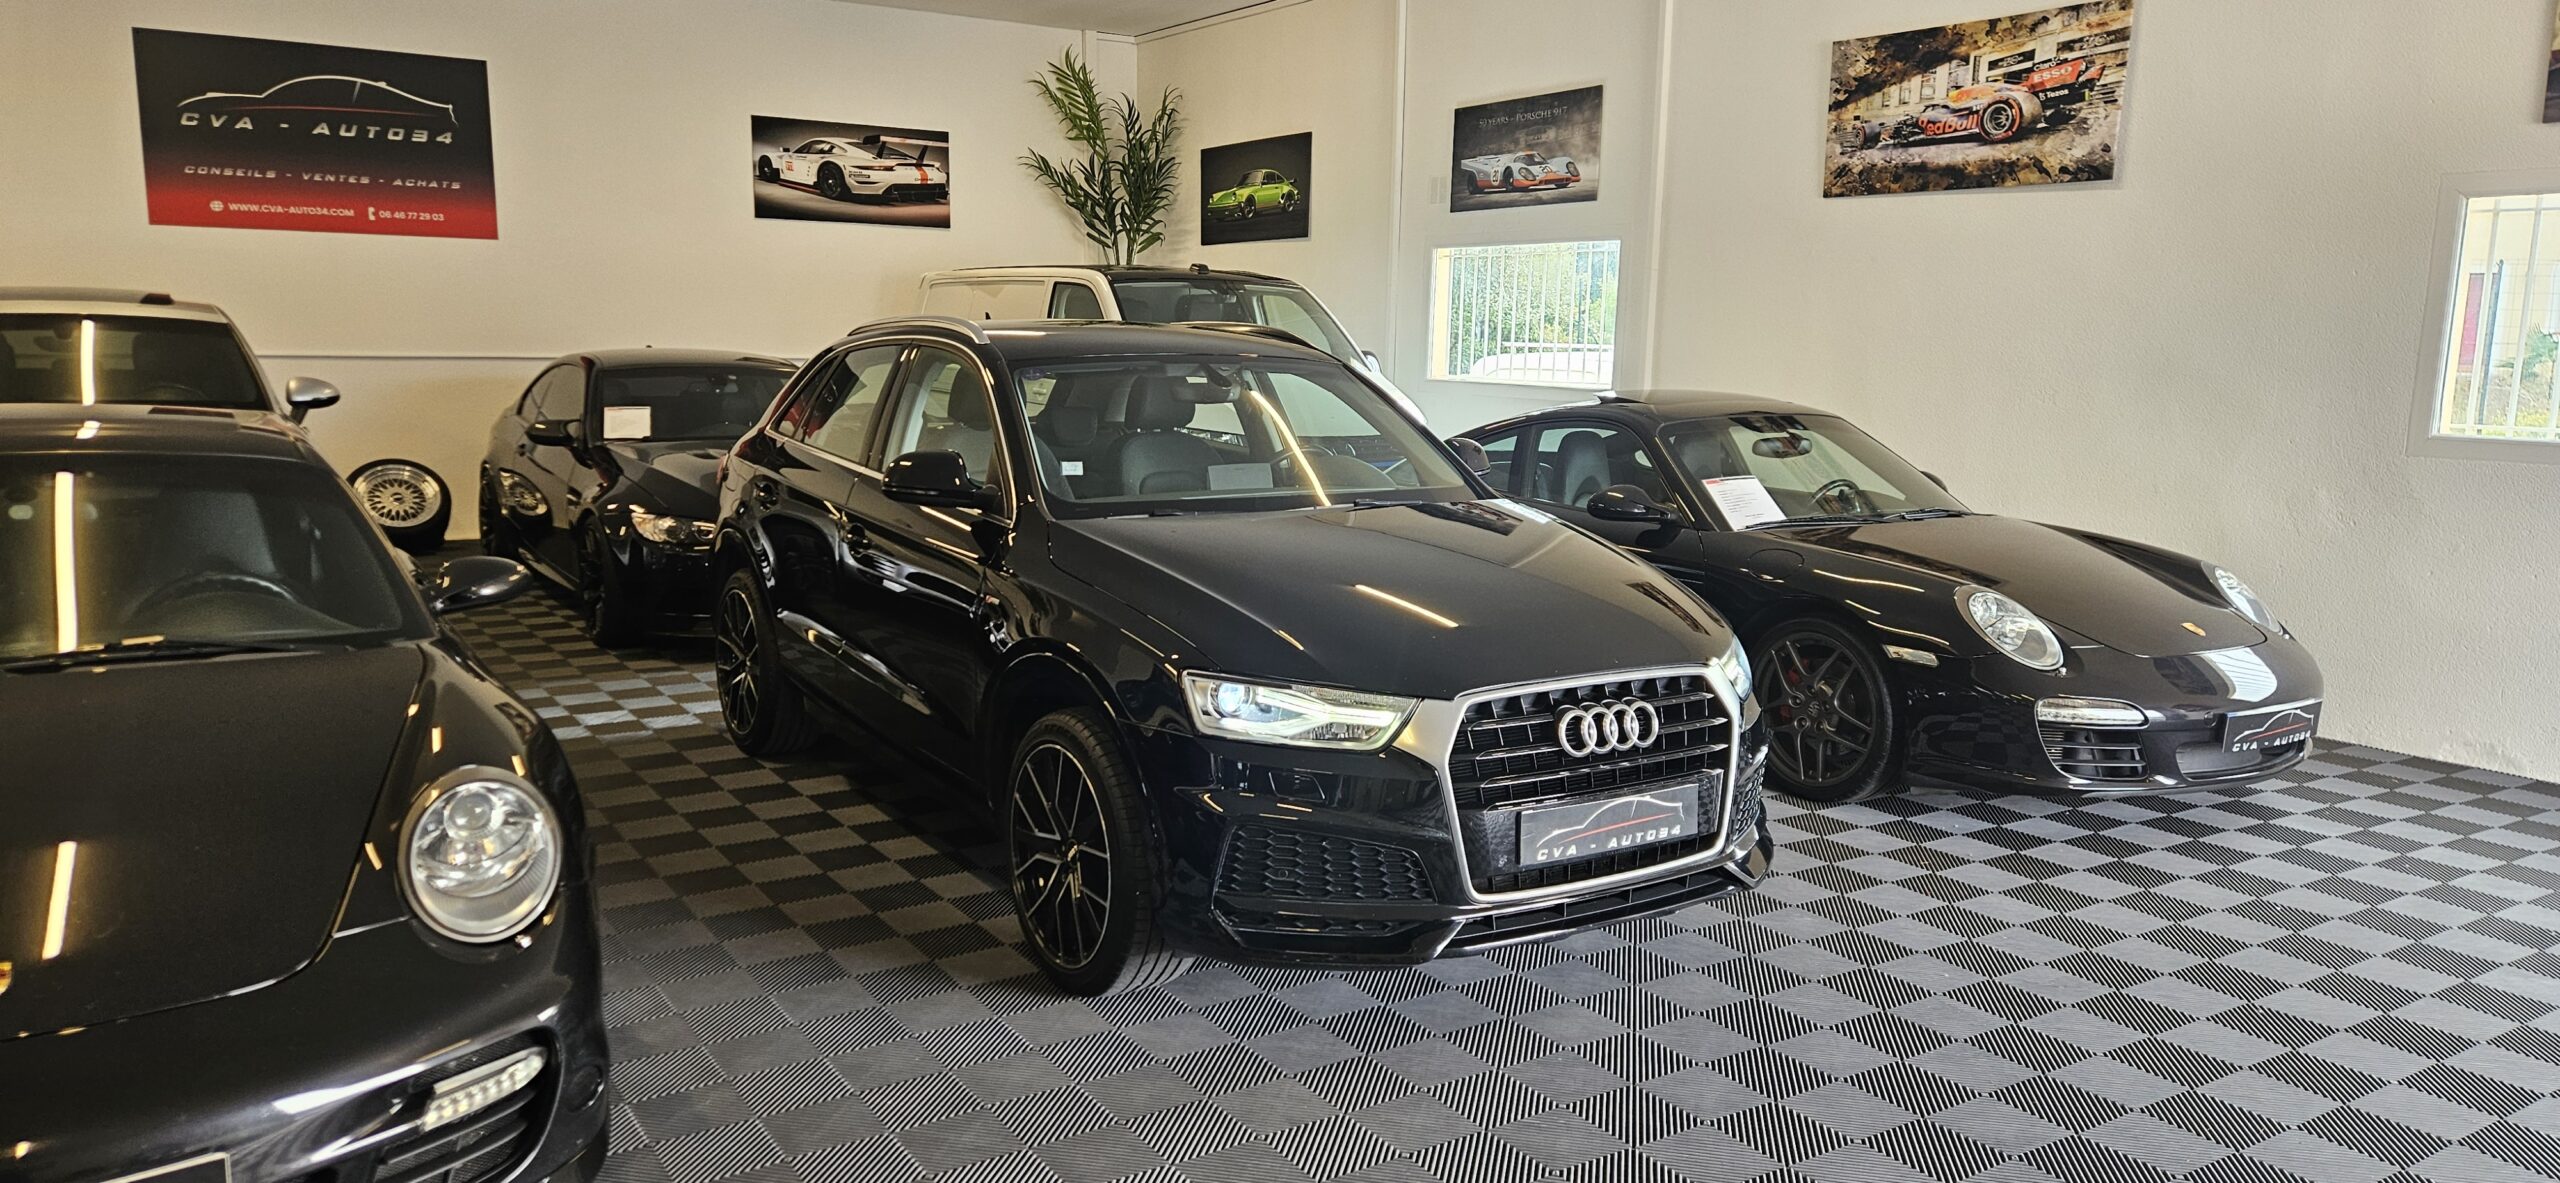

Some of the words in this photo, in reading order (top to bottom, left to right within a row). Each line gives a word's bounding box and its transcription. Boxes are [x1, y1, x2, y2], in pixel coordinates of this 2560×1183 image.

[2046, 88, 2069, 98] Tezos
[1516, 109, 1552, 121] PORSCHE
[1553, 106, 1568, 118] 917
[180, 112, 254, 130] CVA
[312, 122, 453, 144] AUTO34
[184, 165, 276, 178] CONSEILS
[302, 171, 370, 184] VENTES
[393, 178, 461, 189] ACHATS
[228, 203, 355, 216] WWW.CVA-AUTO34.COM
[408, 212, 418, 220] 77
[2232, 741, 2258, 752] CVA
[1536, 844, 1577, 861] CVA
[1608, 824, 1681, 848] AUTO34
